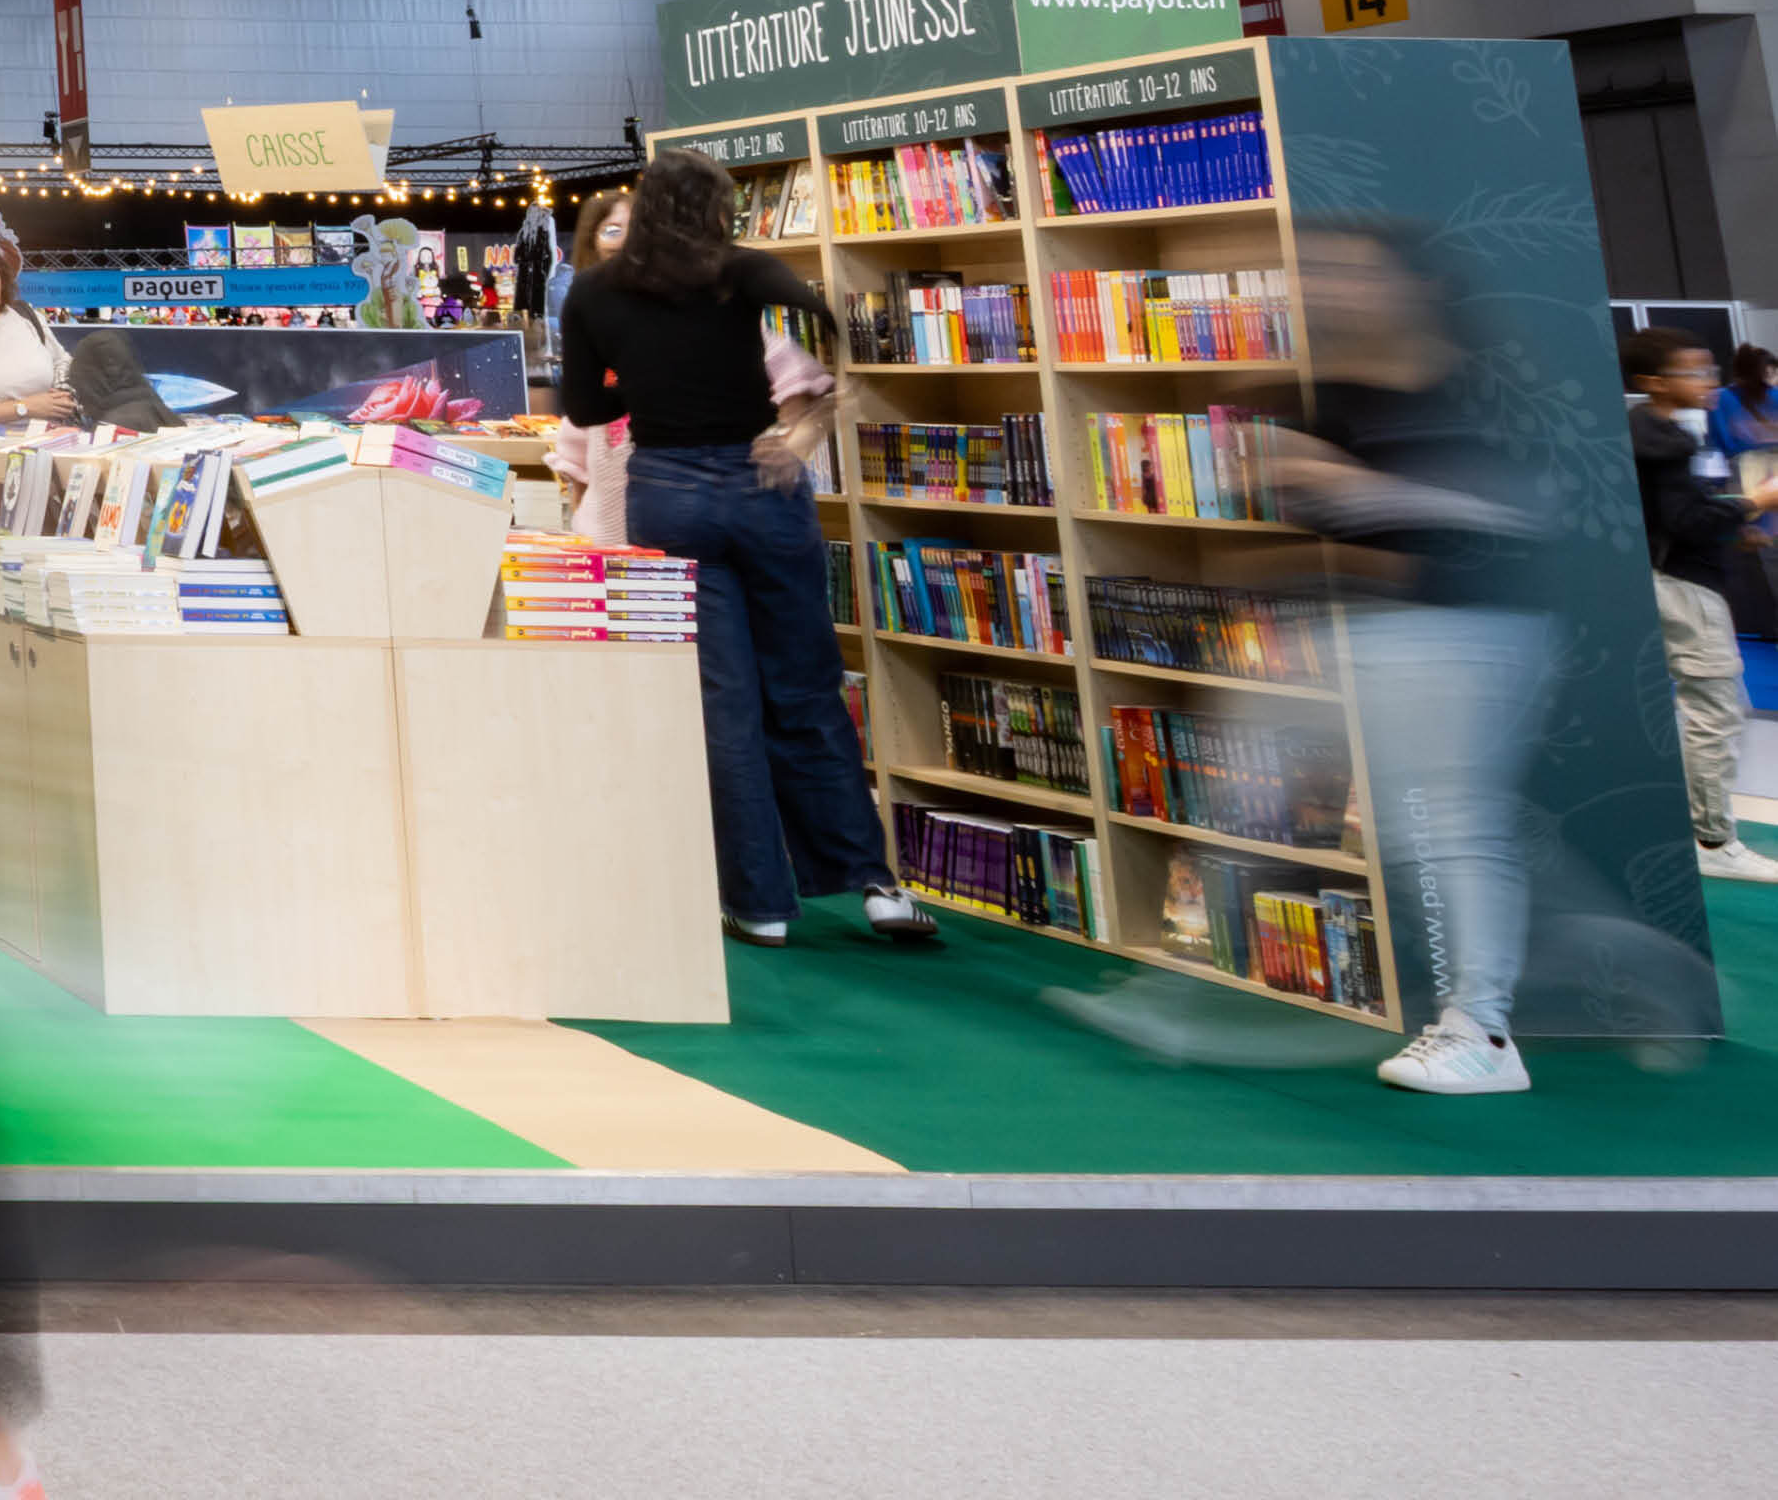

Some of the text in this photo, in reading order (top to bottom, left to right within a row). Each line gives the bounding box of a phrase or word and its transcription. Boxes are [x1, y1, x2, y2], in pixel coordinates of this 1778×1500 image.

[686, 10, 829, 87] LITTÉRATURE
[1050, 66, 1217, 116] LITTÉRATURE 10-12 ANS
[733, 135, 761, 158] 10-12
[766, 132, 785, 153] ANS
[843, 103, 975, 144] LITTÉRATURE 10-12 ANS
[245, 130, 334, 168] CAISSE
[1401, 786, 1449, 998] www.payot.ch
